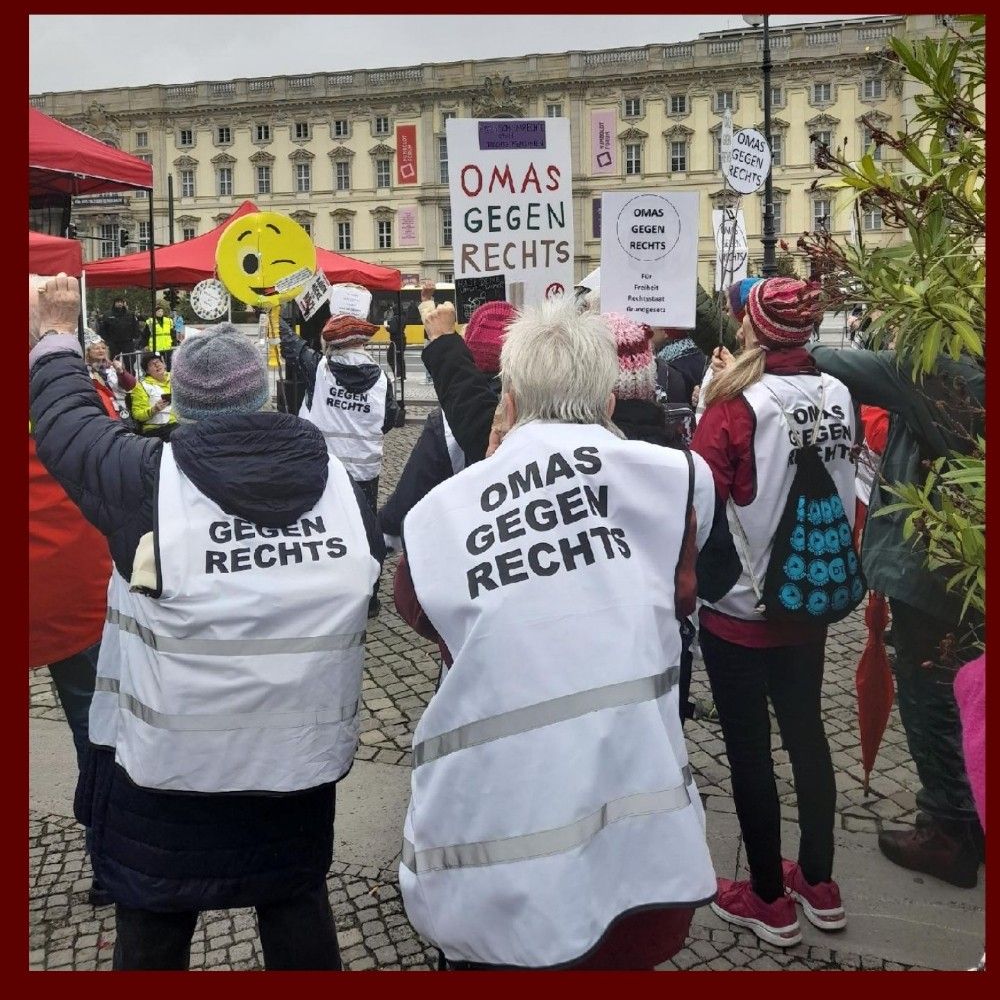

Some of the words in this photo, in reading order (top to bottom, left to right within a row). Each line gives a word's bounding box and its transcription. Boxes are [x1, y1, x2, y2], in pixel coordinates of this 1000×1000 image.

[737, 132, 766, 153] OMAS
[732, 148, 764, 170] GEGEN
[461, 162, 561, 197] OMAS
[729, 164, 763, 187] RECHTS
[464, 201, 566, 233] GEGEN
[633, 208, 664, 217] OMAS
[631, 225, 665, 234] GEGEN
[461, 240, 570, 274] RECHTS
[630, 241, 666, 250] RECHTS
[326, 397, 371, 413] RECHTS
[329, 386, 368, 402] GEGEN
[788, 423, 852, 447] GEGEN
[480, 446, 602, 512] OMAS
[209, 516, 327, 544] GEGEN
[466, 485, 608, 556] GEGEN
[205, 537, 348, 574] RECHTS
[466, 526, 632, 600] RECHTS
